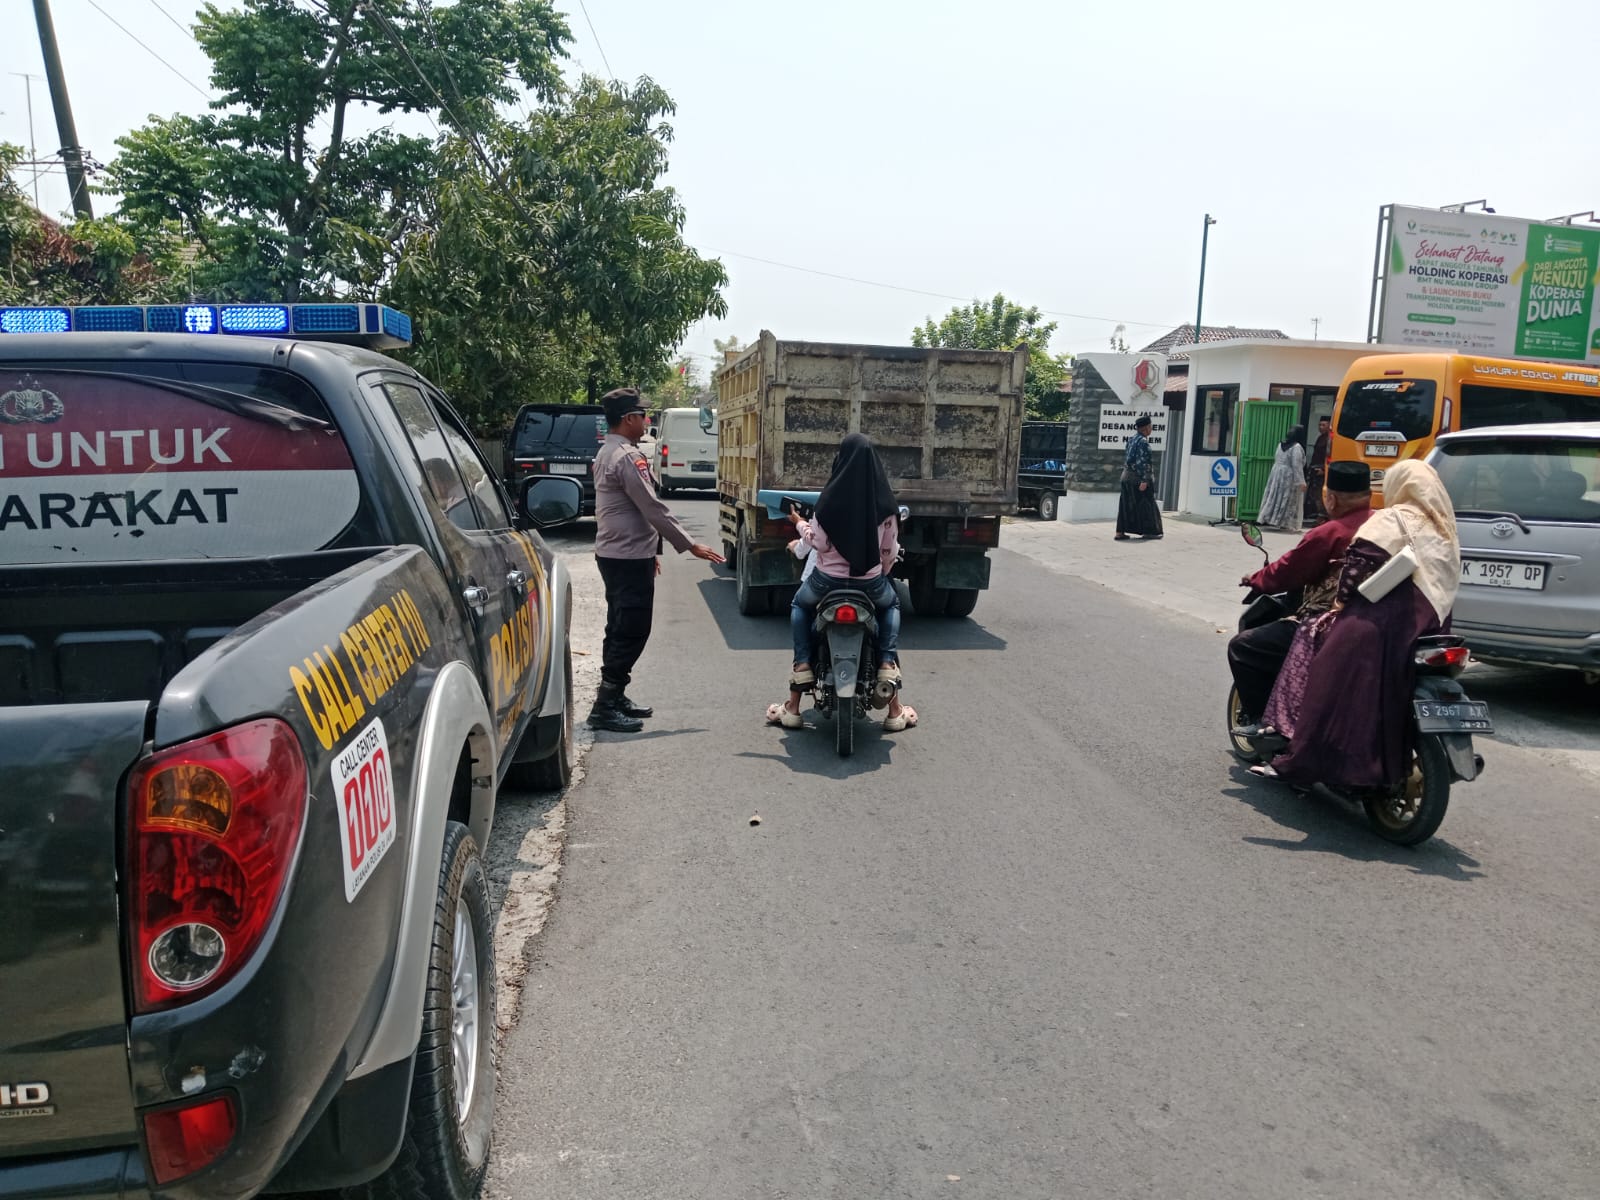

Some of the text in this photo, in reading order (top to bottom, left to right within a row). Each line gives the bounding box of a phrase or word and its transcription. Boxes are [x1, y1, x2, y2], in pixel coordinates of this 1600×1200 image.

[1415, 240, 1505, 267] Selamat Datang
[1533, 256, 1588, 273] DARI ANGGOTA
[1409, 265, 1508, 284] HOLDING KOPERASI
[1417, 276, 1431, 284] BMT
[1445, 279, 1474, 288] NGASEM
[1475, 281, 1499, 290] GROUP
[1531, 269, 1588, 289] MENUJU
[1429, 287, 1471, 298] LAUNCHING
[1529, 284, 1585, 300] KOPERASI
[1526, 299, 1582, 323] DUNIA
[1473, 365, 1598, 384] LUXURY COACH JETBUS
[1102, 422, 1166, 432] DESA NEM
[27, 427, 233, 469] UNTUK
[1101, 435, 1119, 443] KEC
[1462, 562, 1541, 581] K 1957 QP
[490, 601, 534, 714] POLISI
[289, 588, 431, 750] CALL CENTER 110
[1422, 705, 1430, 717] S
[340, 727, 379, 778] CALL CENTER
[344, 747, 391, 872] 110
[22, 1108, 49, 1116] RAIL
